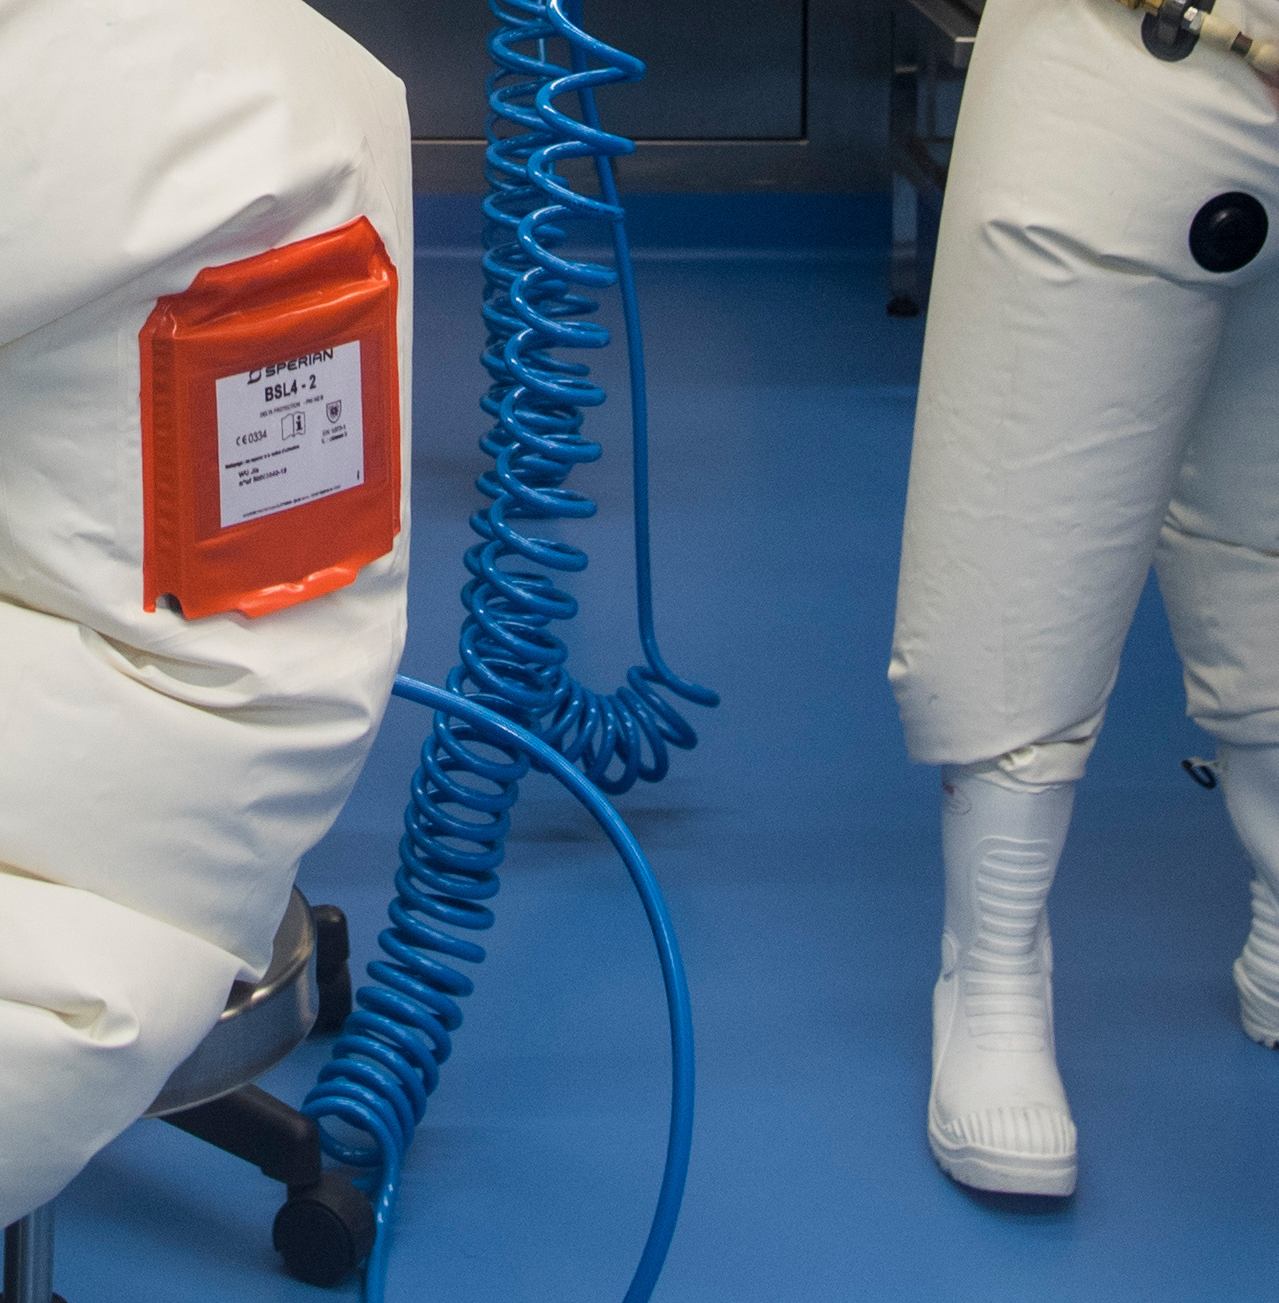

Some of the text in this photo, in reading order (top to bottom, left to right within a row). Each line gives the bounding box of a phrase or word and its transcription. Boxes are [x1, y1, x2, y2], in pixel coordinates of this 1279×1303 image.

[265, 347, 334, 378] SPERIAN
[264, 379, 298, 402] BSL4
[309, 374, 317, 390] 2
